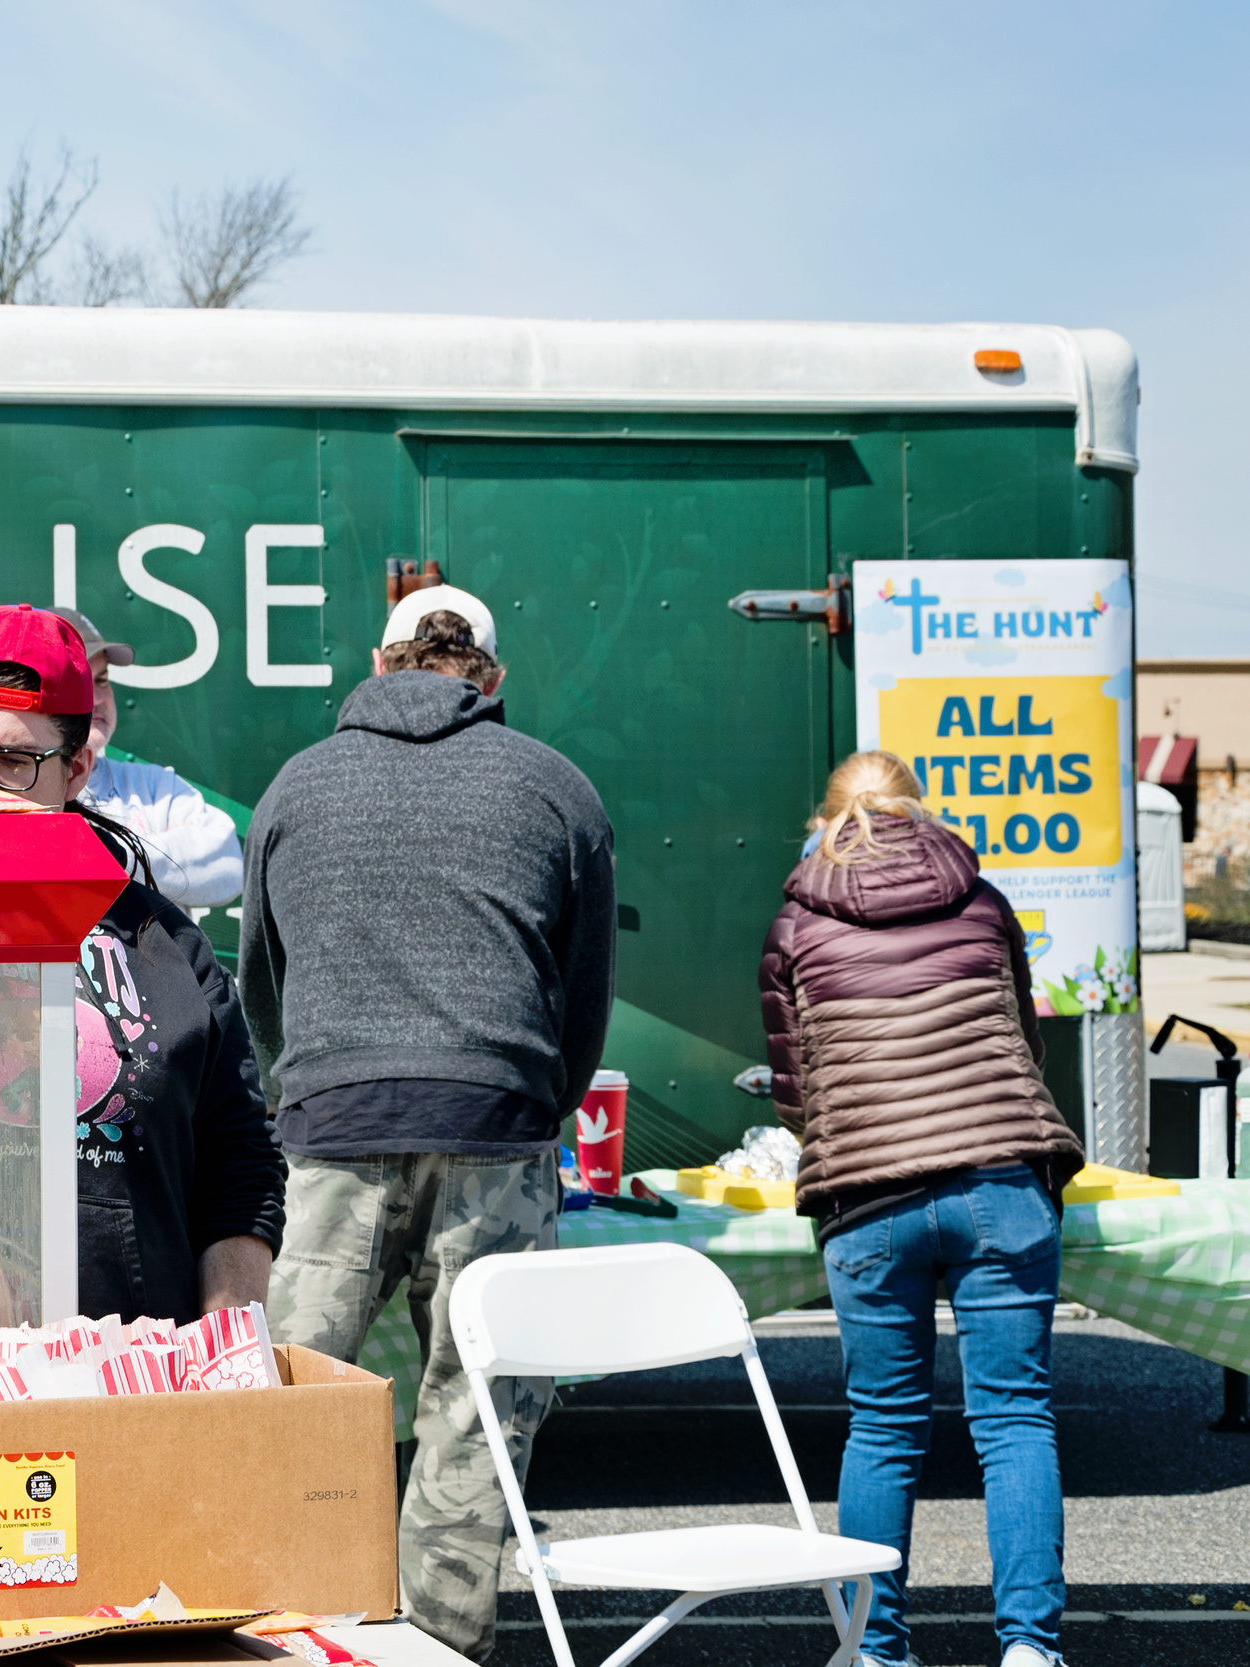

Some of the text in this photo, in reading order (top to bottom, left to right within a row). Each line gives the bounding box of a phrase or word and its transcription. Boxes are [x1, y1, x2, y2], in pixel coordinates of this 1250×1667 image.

[994, 610, 1099, 638] HUNT
[936, 695, 1053, 738] ALL
[914, 753, 1092, 796] ITEMS
[999, 876, 1029, 887] HELP
[1032, 874, 1090, 886] SUPPORT
[1095, 873, 1117, 885] THE
[1065, 888, 1112, 899] LEAGUE
[303, 1489, 358, 1501] 329831-2
[14, 1507, 52, 1520] KITS
